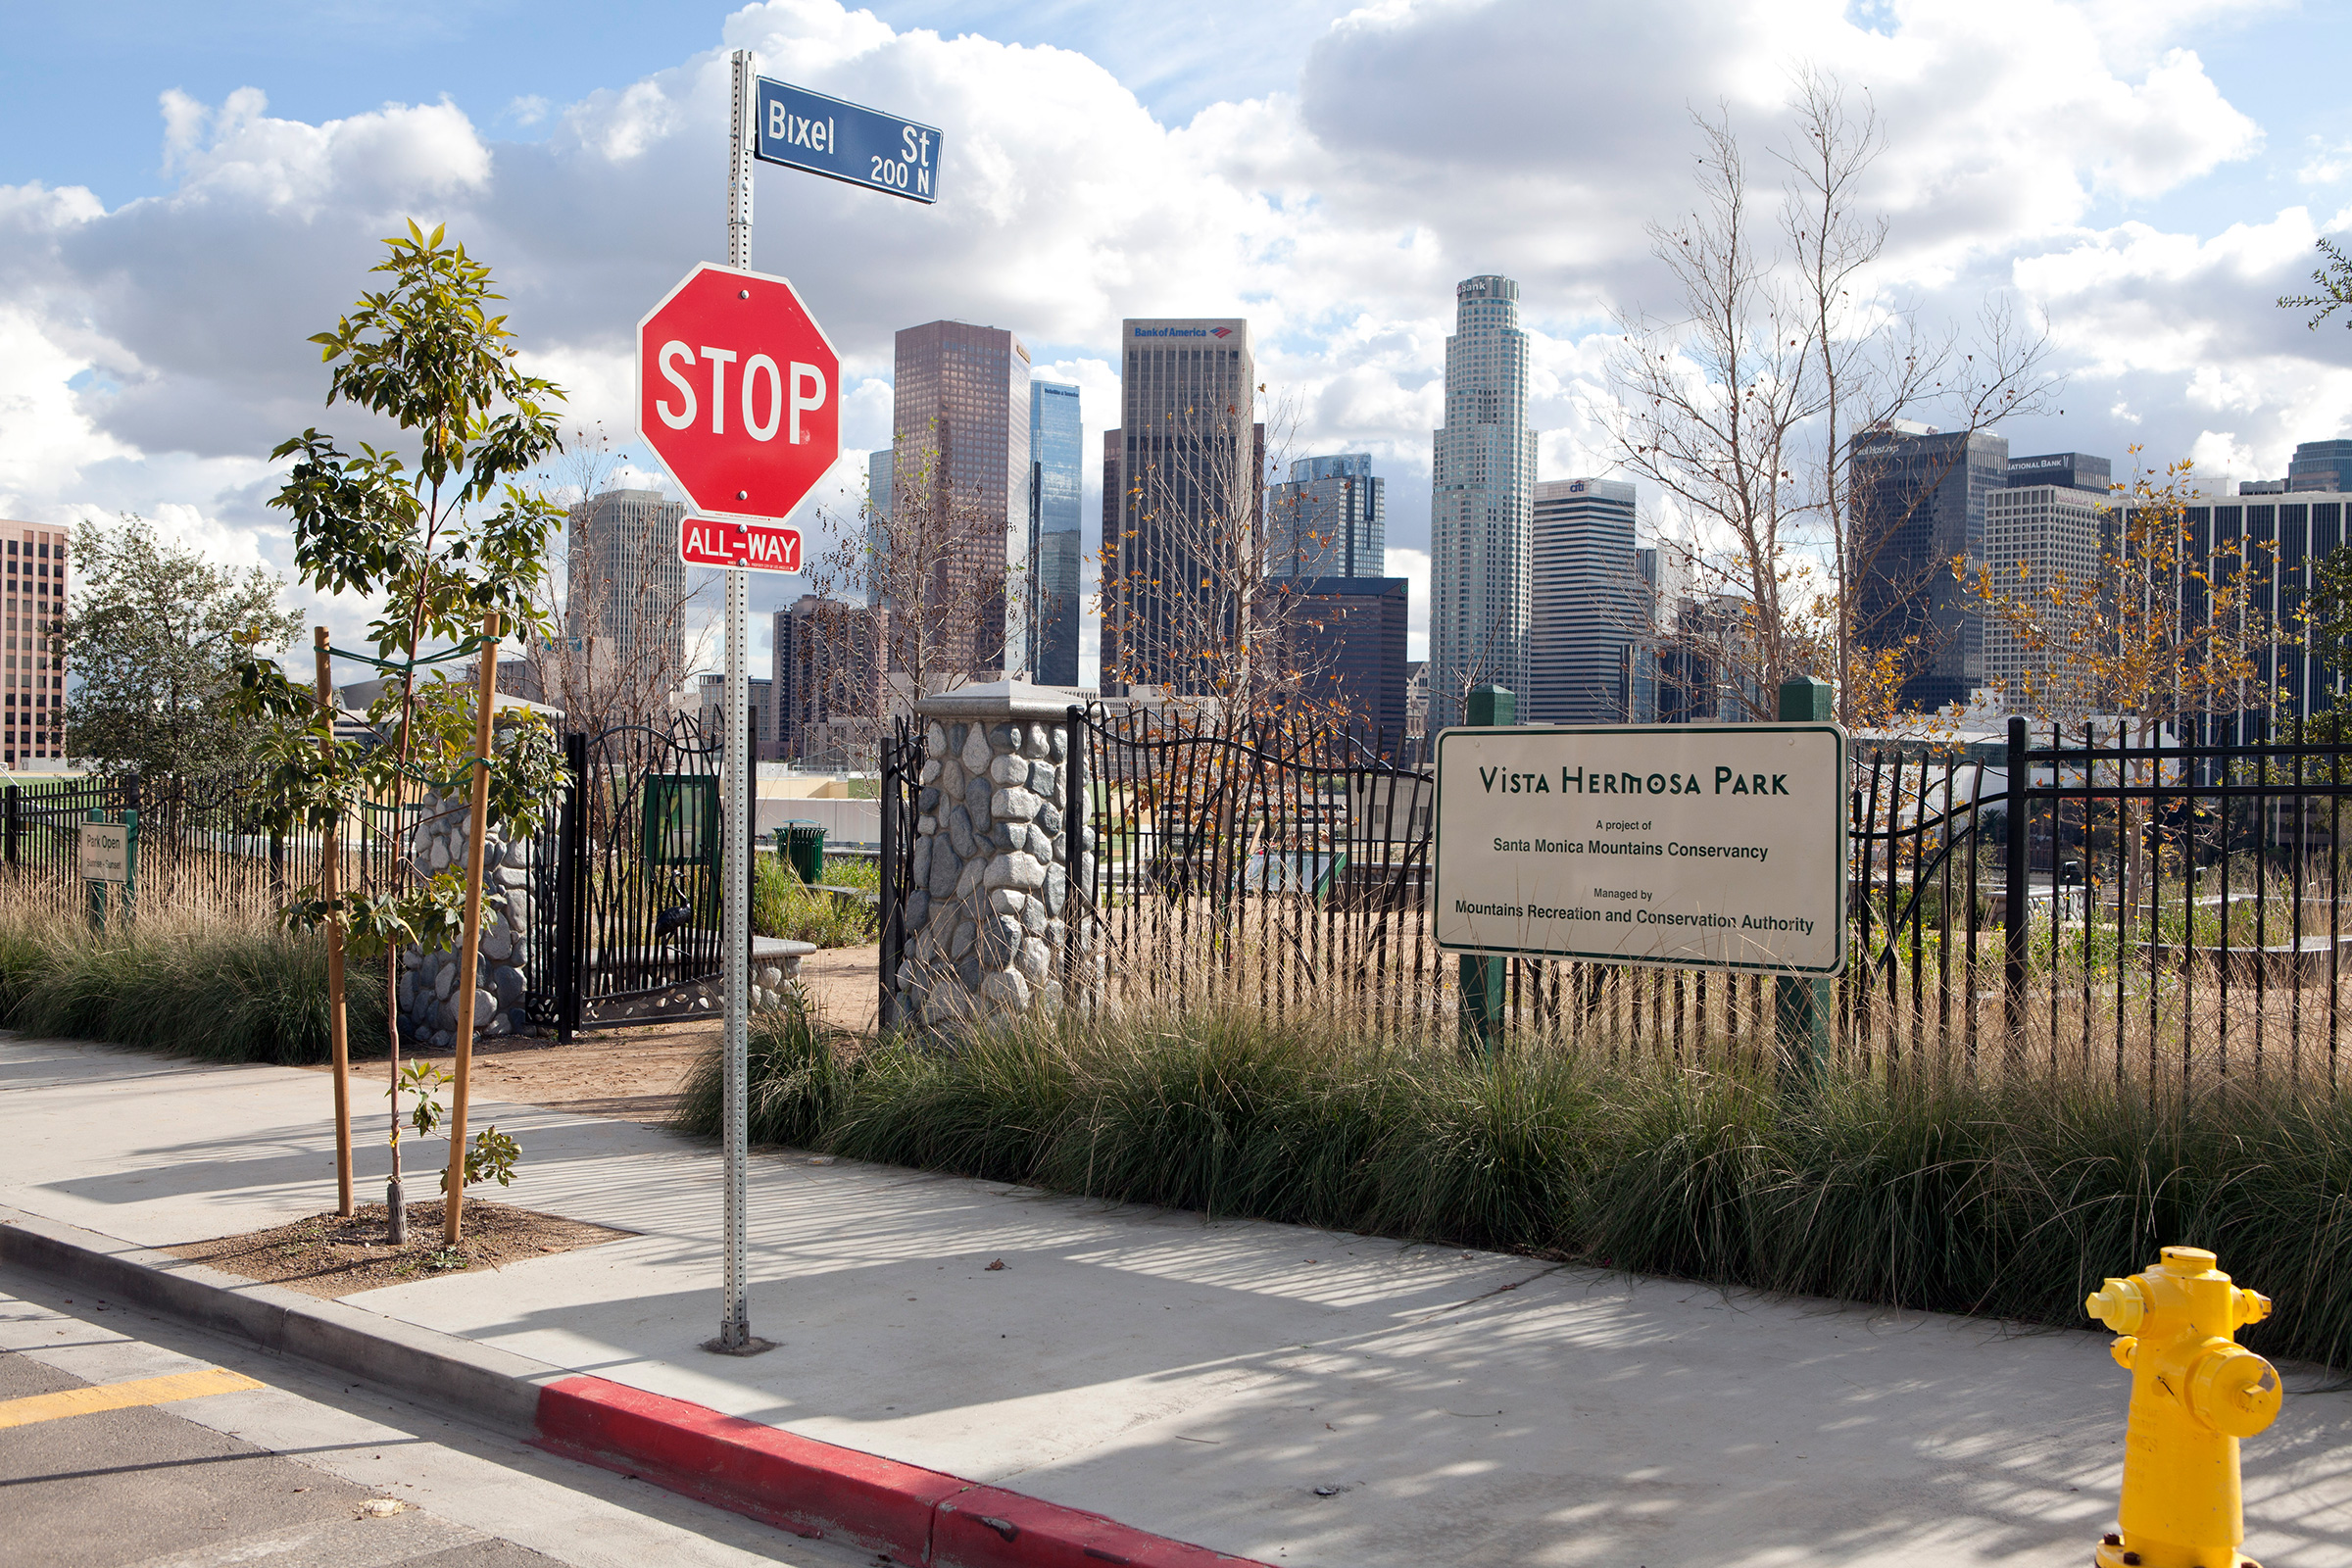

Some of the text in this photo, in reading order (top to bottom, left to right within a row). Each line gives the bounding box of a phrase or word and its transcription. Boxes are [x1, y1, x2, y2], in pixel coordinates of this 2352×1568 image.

[768, 99, 930, 168] Bixel St
[870, 155, 929, 195] 200 N
[1134, 327, 1206, 337] Bank of America
[656, 339, 827, 445] STOP
[1869, 444, 1899, 456] Hastings
[2040, 459, 2062, 468] BANK
[686, 526, 798, 564] ALL-WAY
[1595, 819, 1652, 833] A project of
[86, 834, 120, 852] Park Open
[1493, 837, 1769, 863] Santa Monica Mountains Conservancy
[86, 858, 102, 868] Sunrise
[105, 858, 122, 870] Sunset
[1593, 887, 1653, 903] Managed by
[1455, 900, 1814, 936] Mountains Recreation and Conservation Authority
